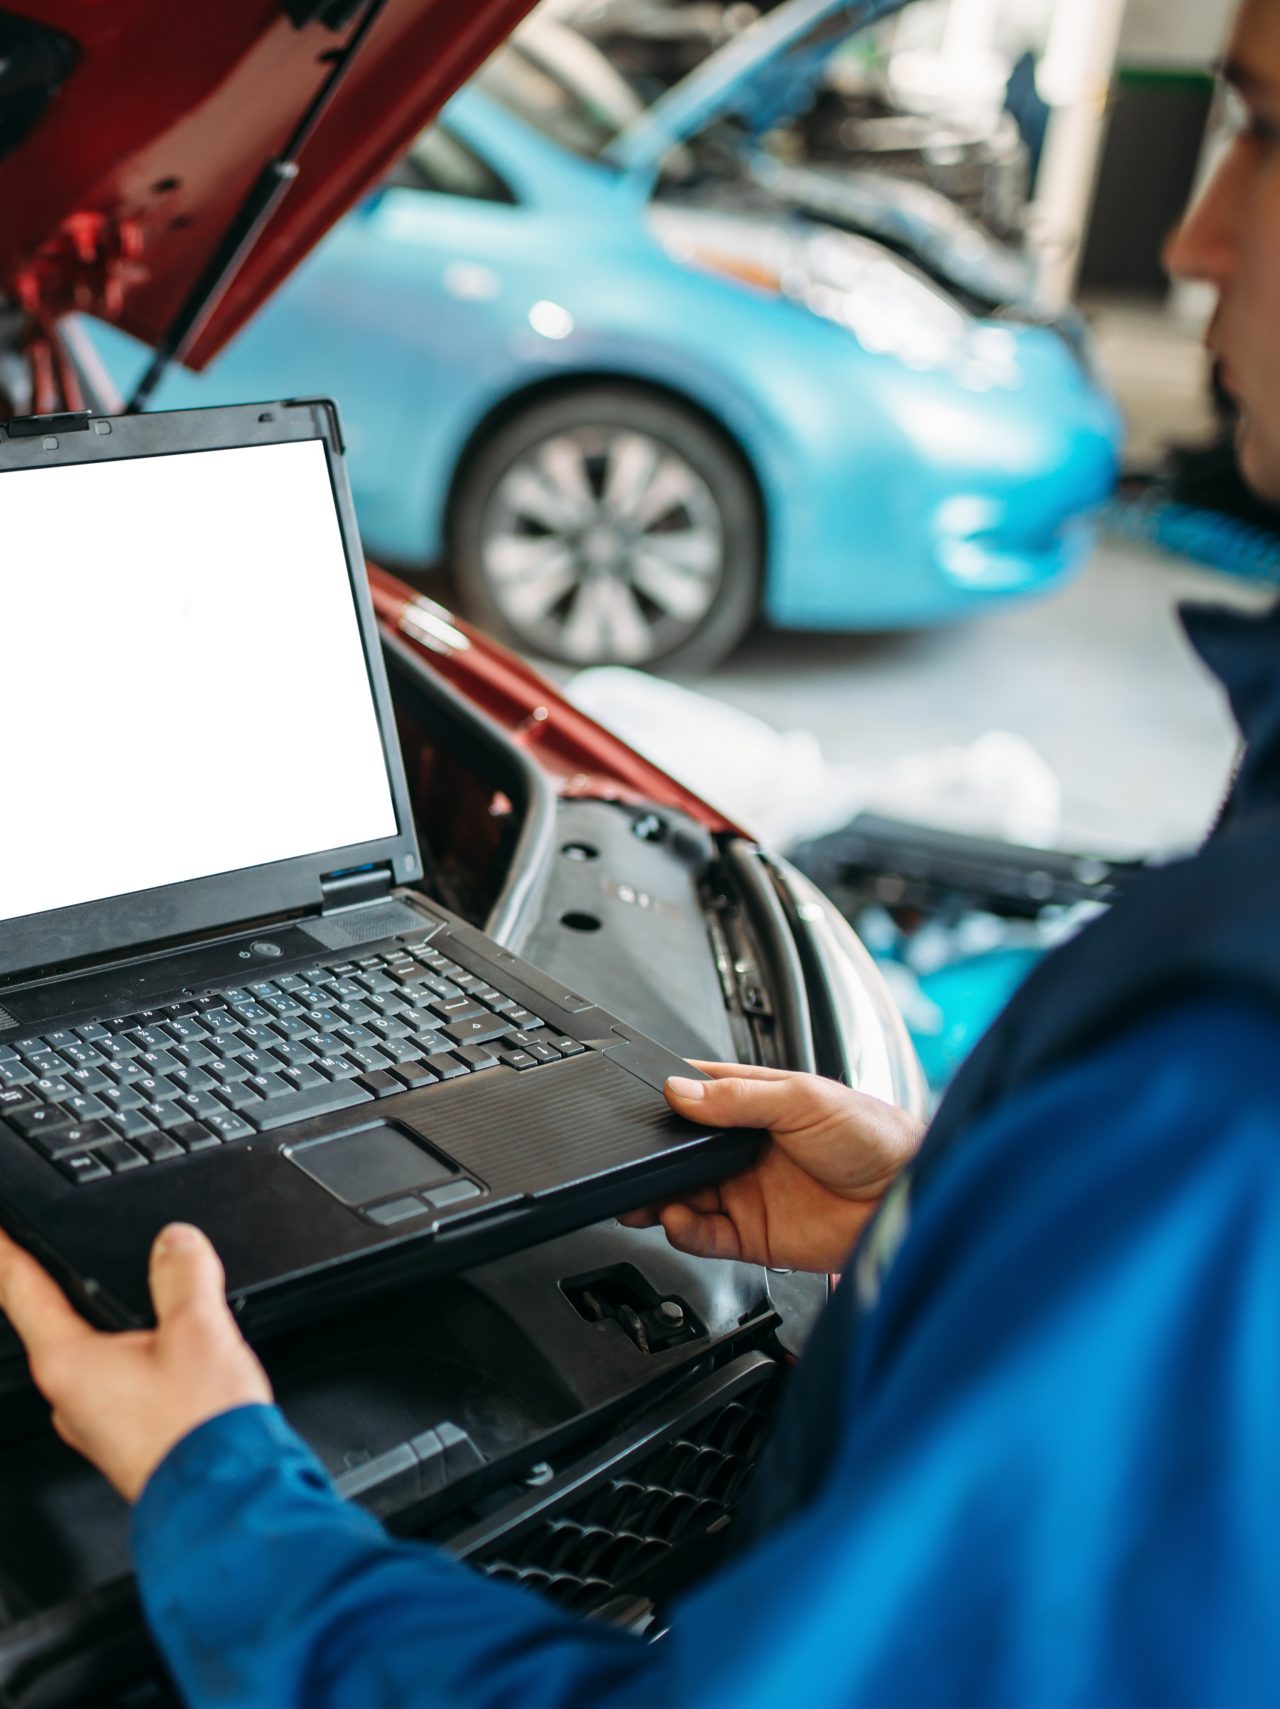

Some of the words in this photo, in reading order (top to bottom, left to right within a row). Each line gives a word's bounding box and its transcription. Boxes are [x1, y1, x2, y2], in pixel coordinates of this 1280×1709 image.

[39, 1080, 52, 1088] Q
[74, 1069, 89, 1079] W
[110, 1062, 122, 1070] E
[212, 1036, 225, 1044] Z
[245, 1028, 257, 1036] U
[310, 1011, 322, 1019] O
[340, 1003, 350, 1011] P
[74, 1098, 86, 1106] A
[108, 1088, 120, 1097] S
[142, 1079, 156, 1088] D
[178, 1070, 188, 1078] F
[213, 1062, 226, 1070] G
[246, 1052, 259, 1060] H
[311, 1036, 324, 1044] K
[375, 1018, 388, 1027] Ö
[406, 1010, 420, 1019] Ä
[115, 1112, 127, 1122] Y
[150, 1104, 164, 1113] X
[187, 1094, 200, 1103] C
[220, 1085, 233, 1094] V
[255, 1076, 268, 1084] B
[288, 1067, 302, 1076] N
[320, 1058, 336, 1067] M
